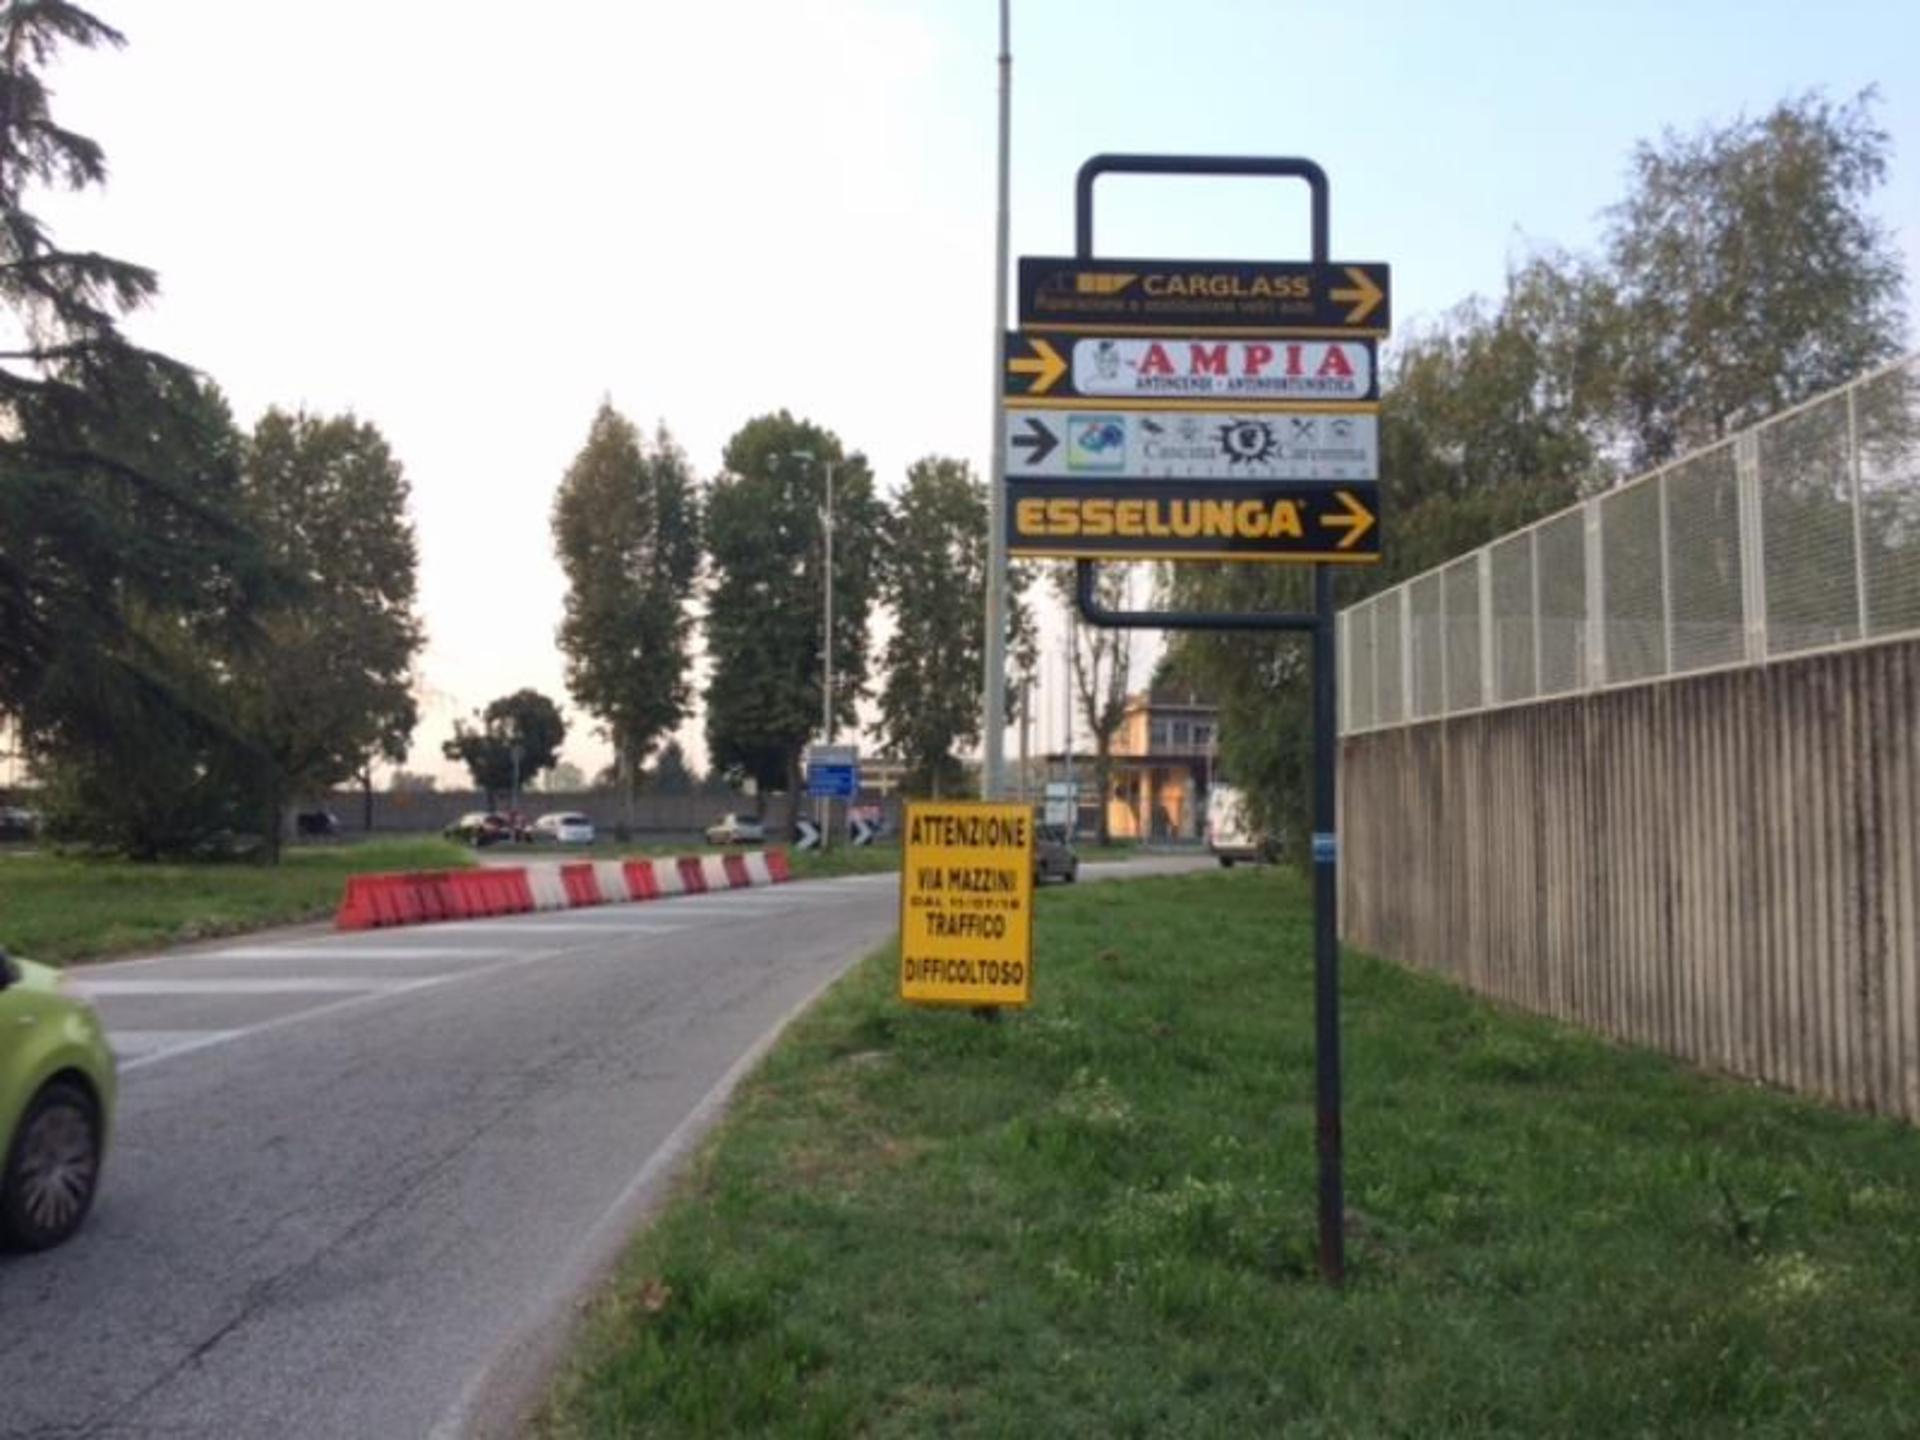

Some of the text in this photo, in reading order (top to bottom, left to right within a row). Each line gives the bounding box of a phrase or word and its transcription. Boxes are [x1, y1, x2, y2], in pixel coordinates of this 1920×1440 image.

[1143, 275, 1311, 298] CARGLASS
[1139, 343, 1355, 376] AMPIA
[1016, 499, 1302, 537] ESSELUNGA
[911, 816, 1026, 846] ATTENZIONE
[918, 868, 942, 890] VIA
[926, 912, 1006, 939] TRAFFICO
[905, 957, 1024, 985] DIFFICOLTOSO
